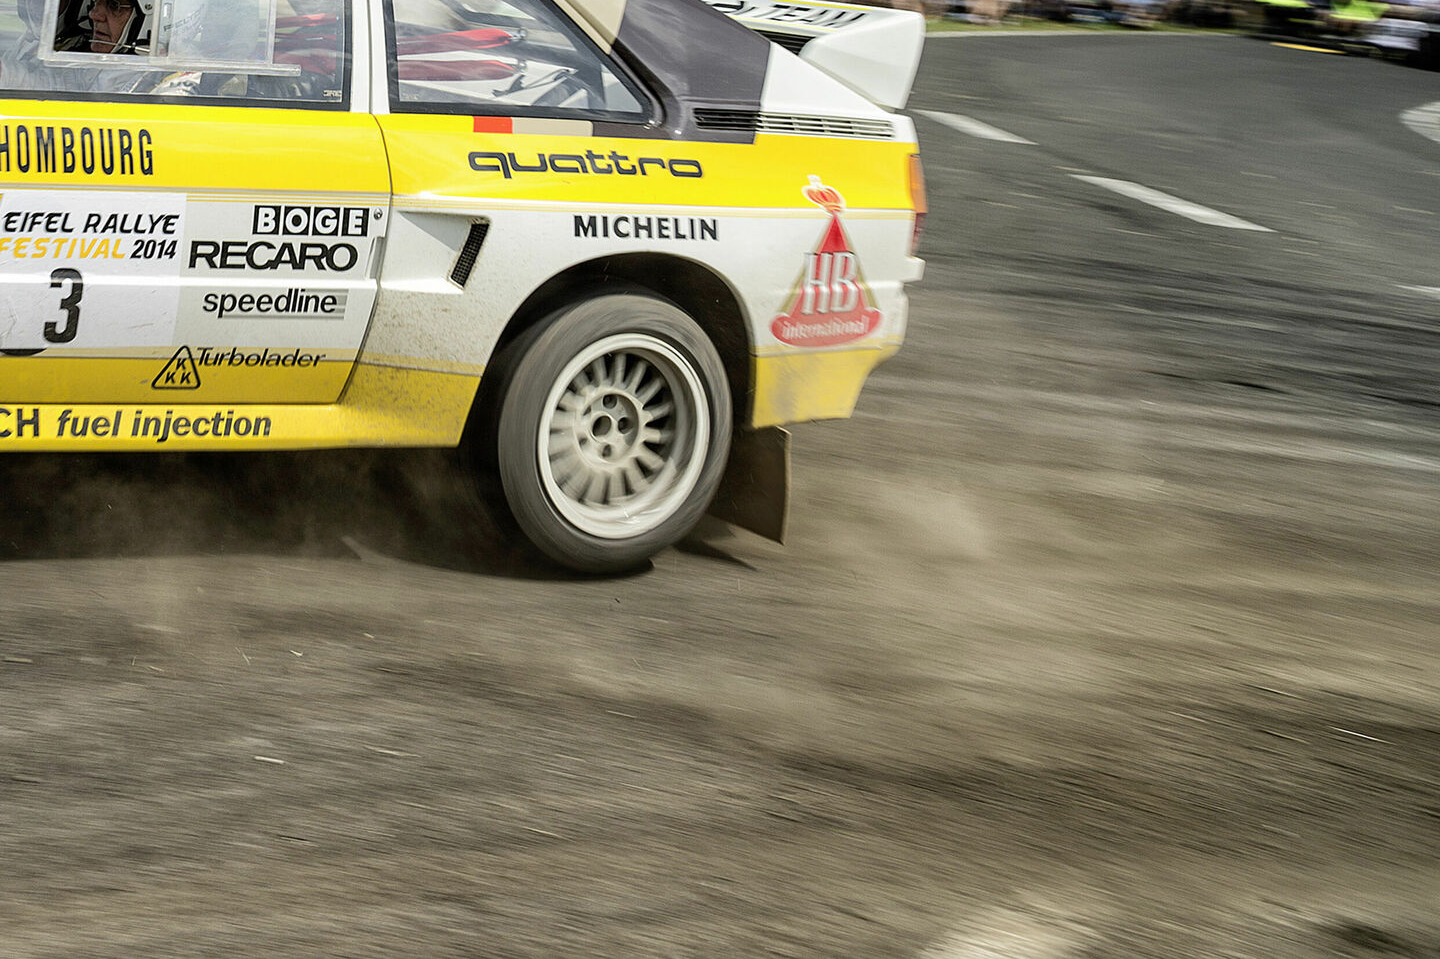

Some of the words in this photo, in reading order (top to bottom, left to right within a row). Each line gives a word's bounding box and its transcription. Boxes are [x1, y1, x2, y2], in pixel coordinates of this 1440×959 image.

[753, 4, 866, 28] TEAM
[468, 149, 704, 179] quattro
[2, 211, 74, 233] EIFEL
[83, 213, 180, 235] RALLYE
[253, 205, 369, 236] BOGE
[573, 214, 719, 241] MICHELIN
[130, 239, 179, 260] 2014
[188, 240, 359, 272] RECARO
[802, 251, 859, 315] HB
[43, 267, 83, 344] 3
[202, 288, 337, 319] speedline
[197, 347, 326, 367] Turbolader
[57, 409, 123, 437] fuel
[131, 410, 271, 443] injection
